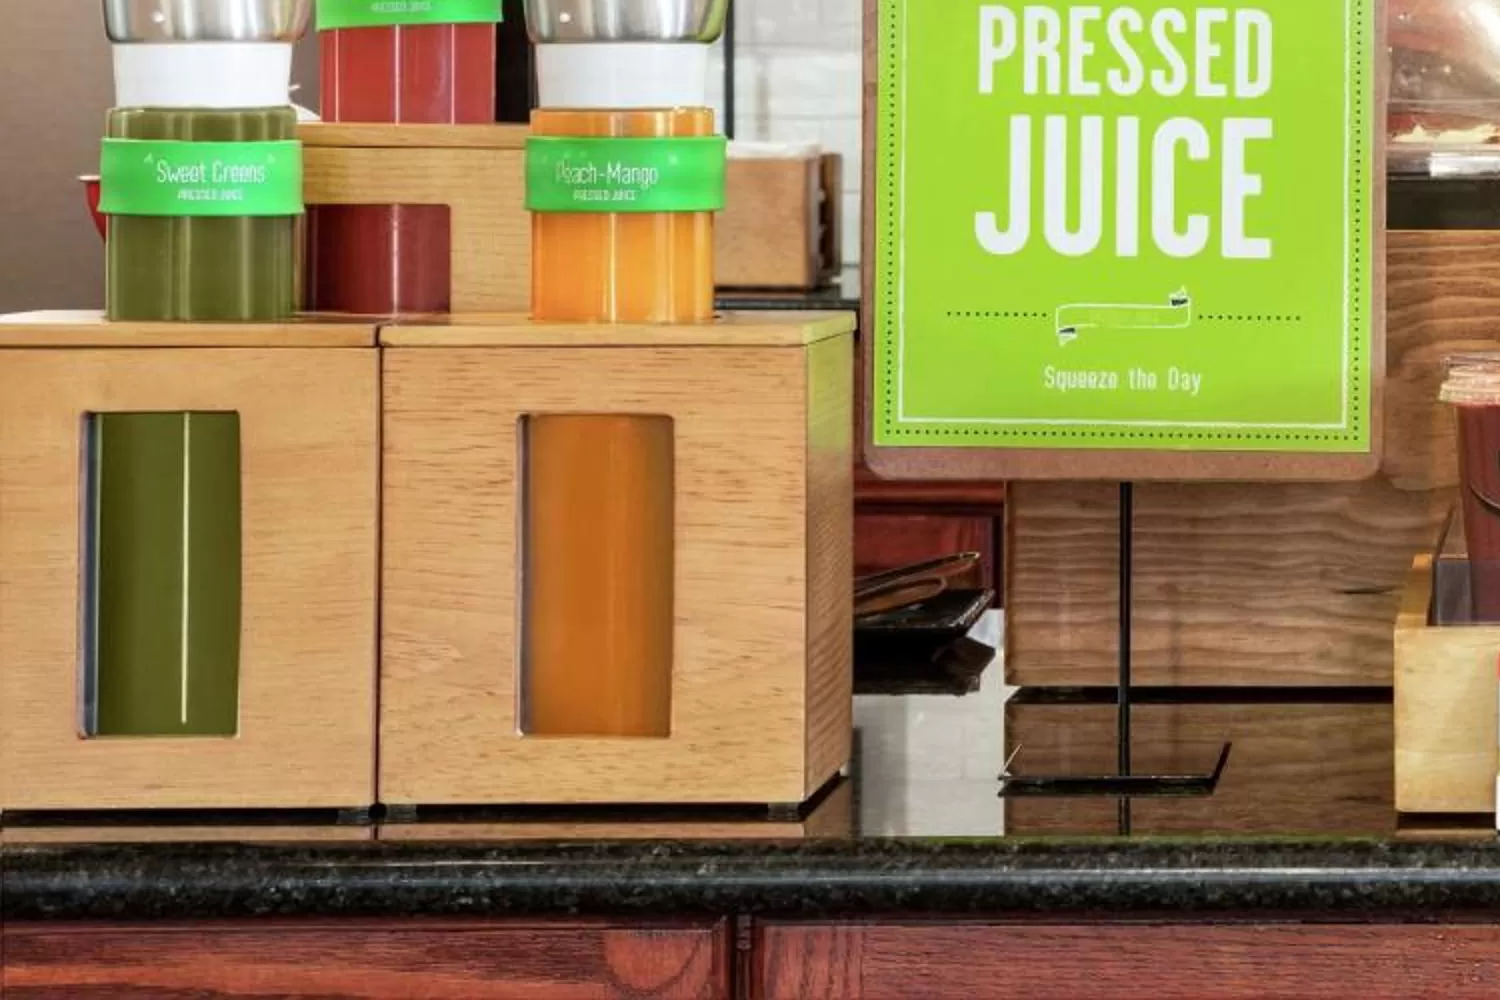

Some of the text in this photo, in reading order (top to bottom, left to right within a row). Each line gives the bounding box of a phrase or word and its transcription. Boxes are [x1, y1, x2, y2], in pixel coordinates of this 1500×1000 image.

[977, 5, 1273, 98] PRESSED
[156, 159, 206, 184] Sweet
[974, 114, 1273, 258] JUICE
[1043, 364, 1202, 396] Squeeze the Day
